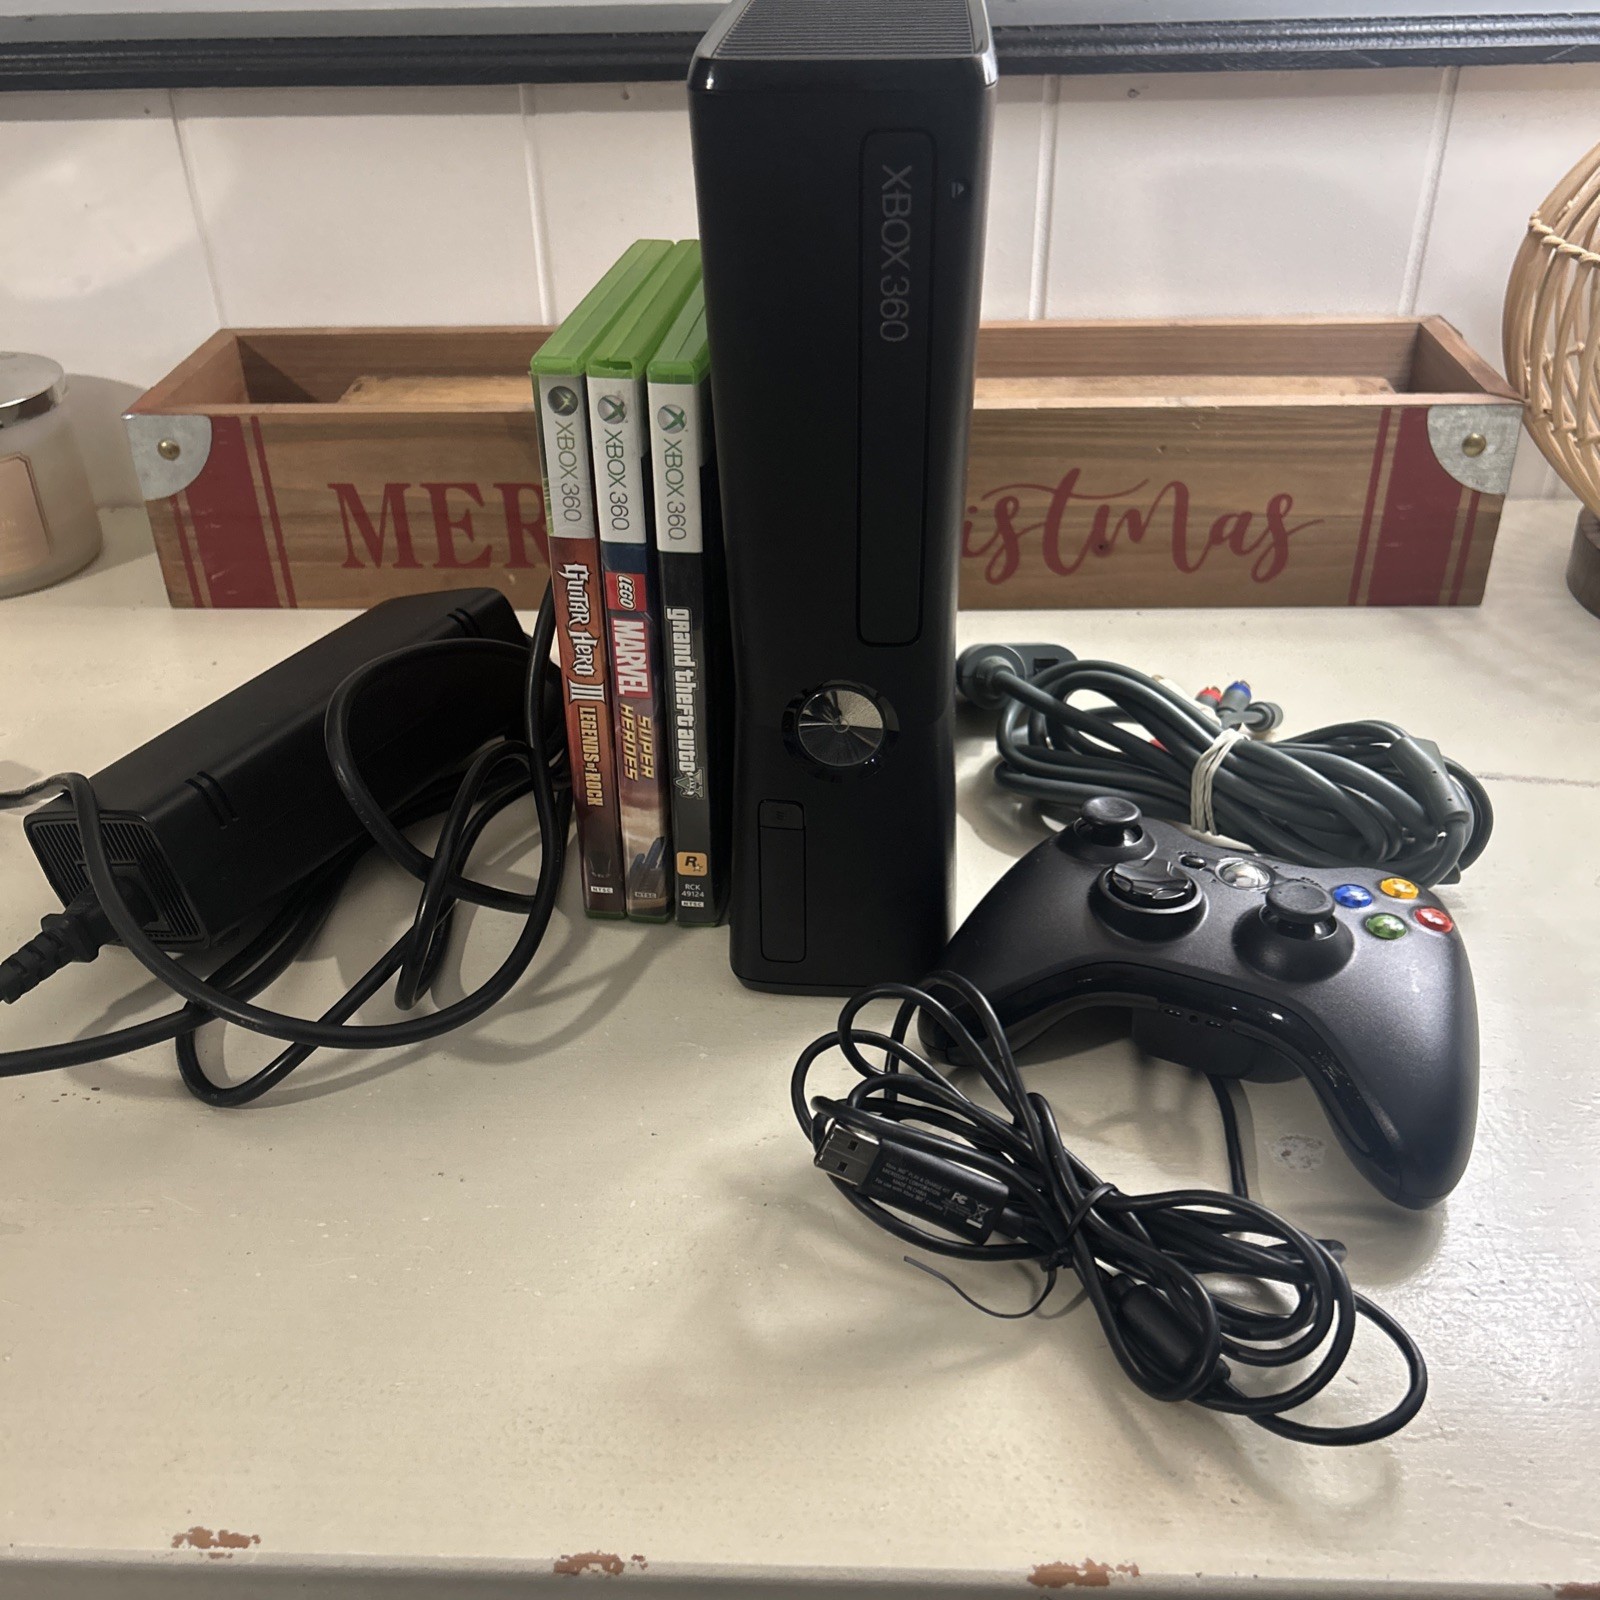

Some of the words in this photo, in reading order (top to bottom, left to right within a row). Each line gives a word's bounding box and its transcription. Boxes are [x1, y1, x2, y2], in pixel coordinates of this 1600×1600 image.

[881, 164, 912, 271] XBOX
[880, 275, 910, 342] 360
[555, 421, 579, 479] XBOX
[604, 429, 627, 488] XBOX
[663, 438, 685, 497] XBOX
[561, 483, 582, 522] 360
[609, 492, 630, 531] 360
[667, 501, 687, 540] 360
[617, 575, 635, 610] LEGO
[614, 619, 649, 695] MARVEL
[666, 607, 697, 667] grand
[568, 679, 605, 703] III
[674, 669, 697, 727] theft
[579, 707, 600, 763] LEGENDS
[620, 703, 638, 781] HEROES
[636, 715, 654, 779] SUPER
[676, 728, 697, 772] auto
[585, 772, 603, 806] ROCK
[685, 856, 699, 868] R
[681, 890, 705, 898] 49124
